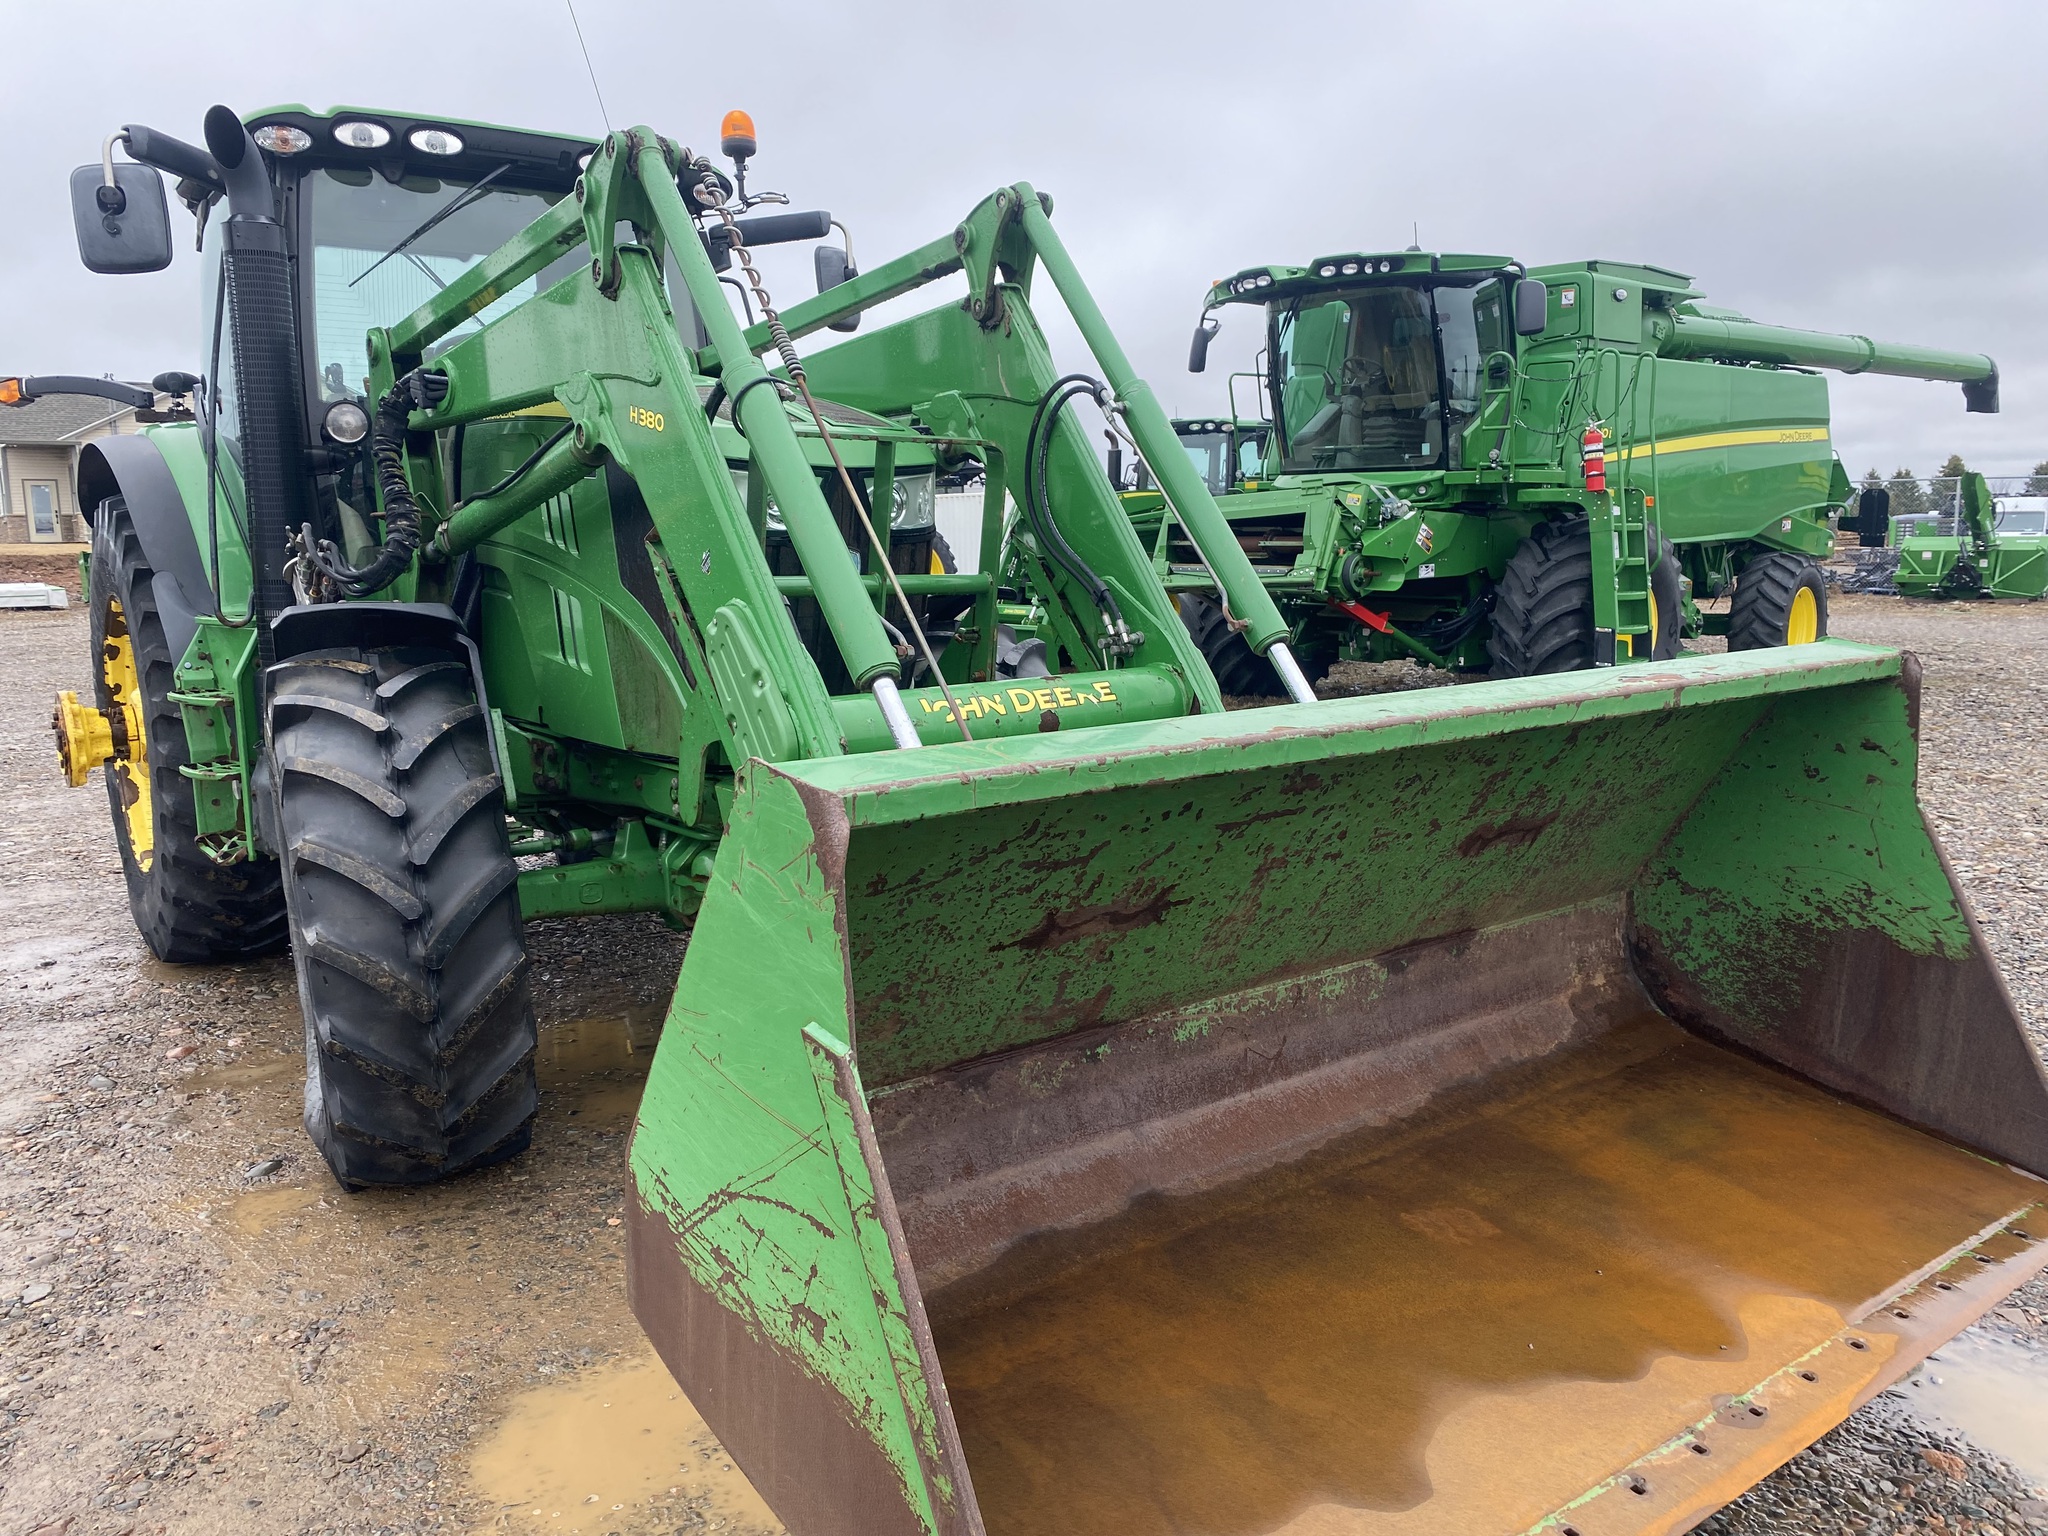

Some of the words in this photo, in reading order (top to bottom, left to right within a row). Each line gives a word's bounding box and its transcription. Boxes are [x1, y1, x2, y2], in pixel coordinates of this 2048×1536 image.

[629, 404, 665, 432] H380
[1779, 431, 1795, 442] JOHN
[1794, 431, 1813, 441] DEERE
